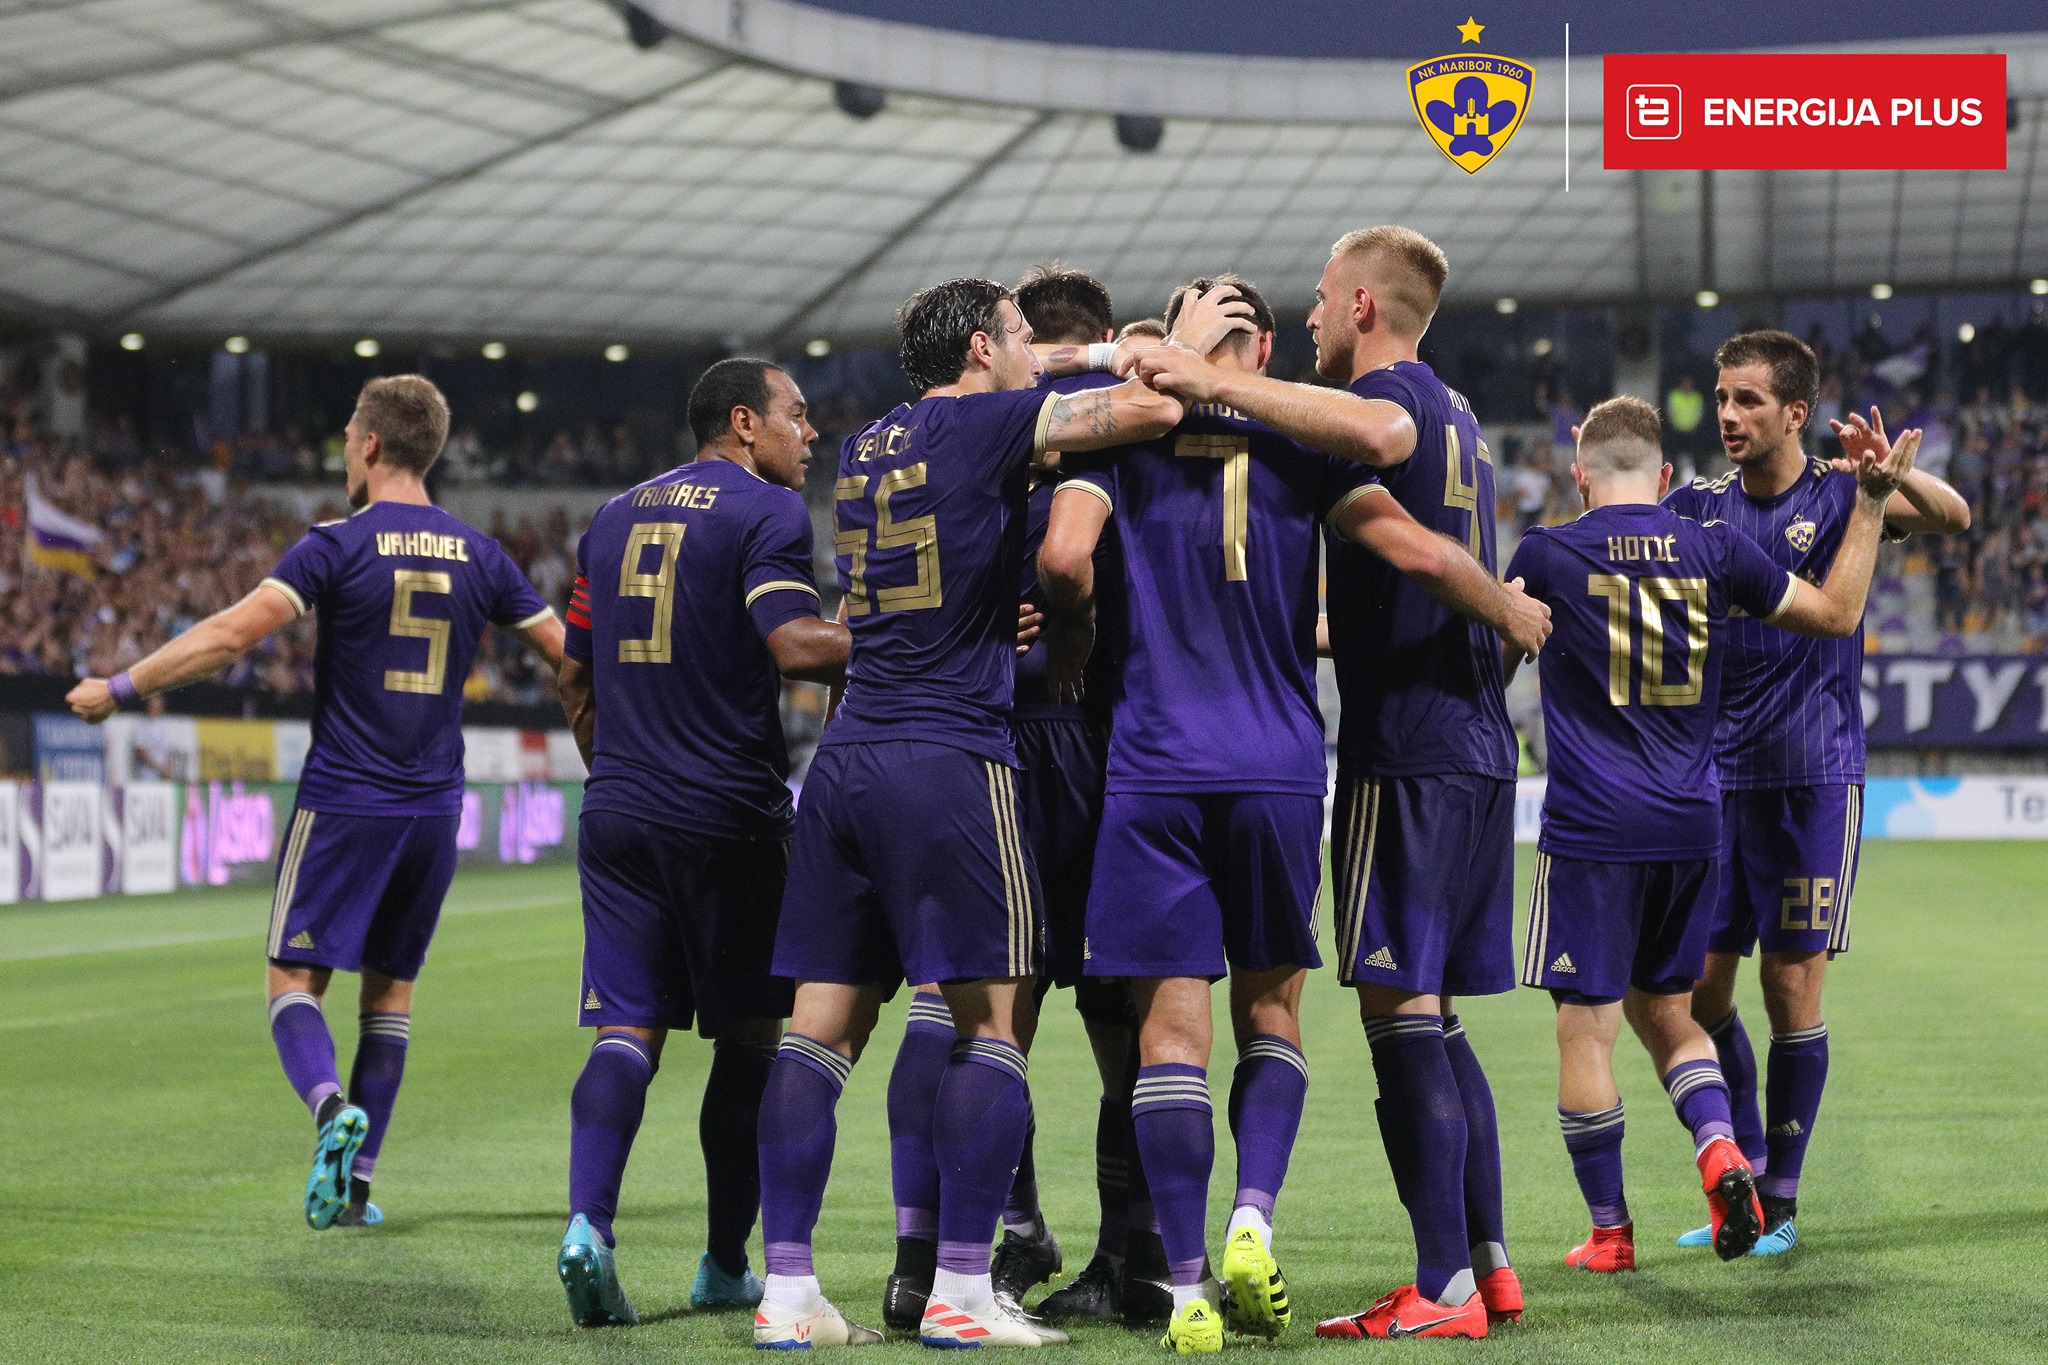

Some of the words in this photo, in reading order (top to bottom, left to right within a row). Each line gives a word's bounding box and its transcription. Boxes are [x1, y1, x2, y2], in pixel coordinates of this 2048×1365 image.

[1175, 434, 1249, 581] 7
[1608, 535, 1680, 562] HOTIĆ
[384, 569, 452, 695] 5
[617, 523, 687, 663] 9
[1588, 574, 1708, 706] 10
[1781, 878, 1835, 930] 28
[1364, 958, 1397, 970] adidas
[1550, 965, 1577, 974] adidas
